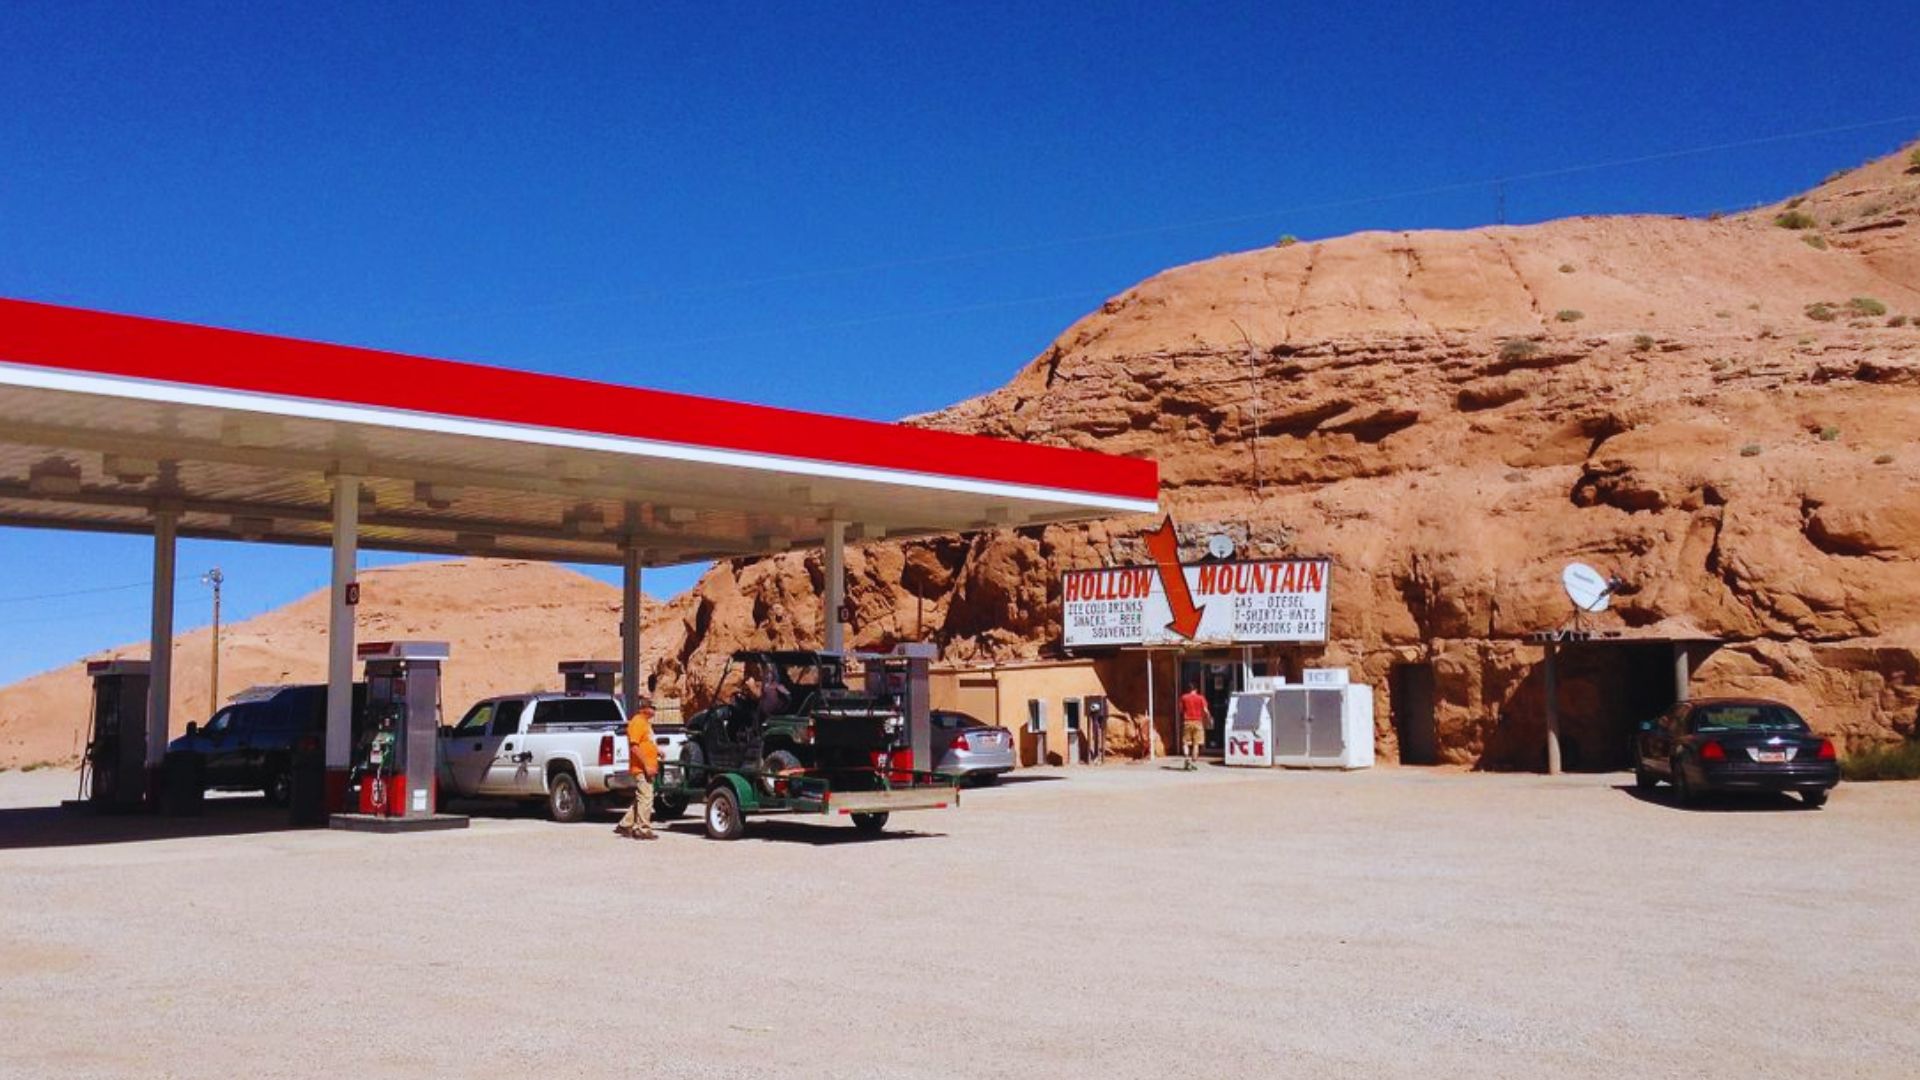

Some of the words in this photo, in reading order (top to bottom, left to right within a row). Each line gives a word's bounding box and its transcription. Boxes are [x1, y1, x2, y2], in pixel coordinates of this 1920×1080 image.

[1066, 569, 1154, 602] HOLLOW
[1197, 562, 1325, 596] MOUNTAIN
[1085, 602, 1107, 615] COLD
[1108, 601, 1143, 613] DRINKS
[1235, 597, 1253, 608] GAS
[1267, 596, 1304, 608] DIESEL
[1074, 615, 1106, 627] SNACKS
[1120, 614, 1141, 625] BEER
[1092, 626, 1142, 638] SOUVENIRS
[1297, 622, 1324, 634] BAIT
[1306, 671, 1333, 681] ICE
[1230, 741, 1264, 756] ICE
